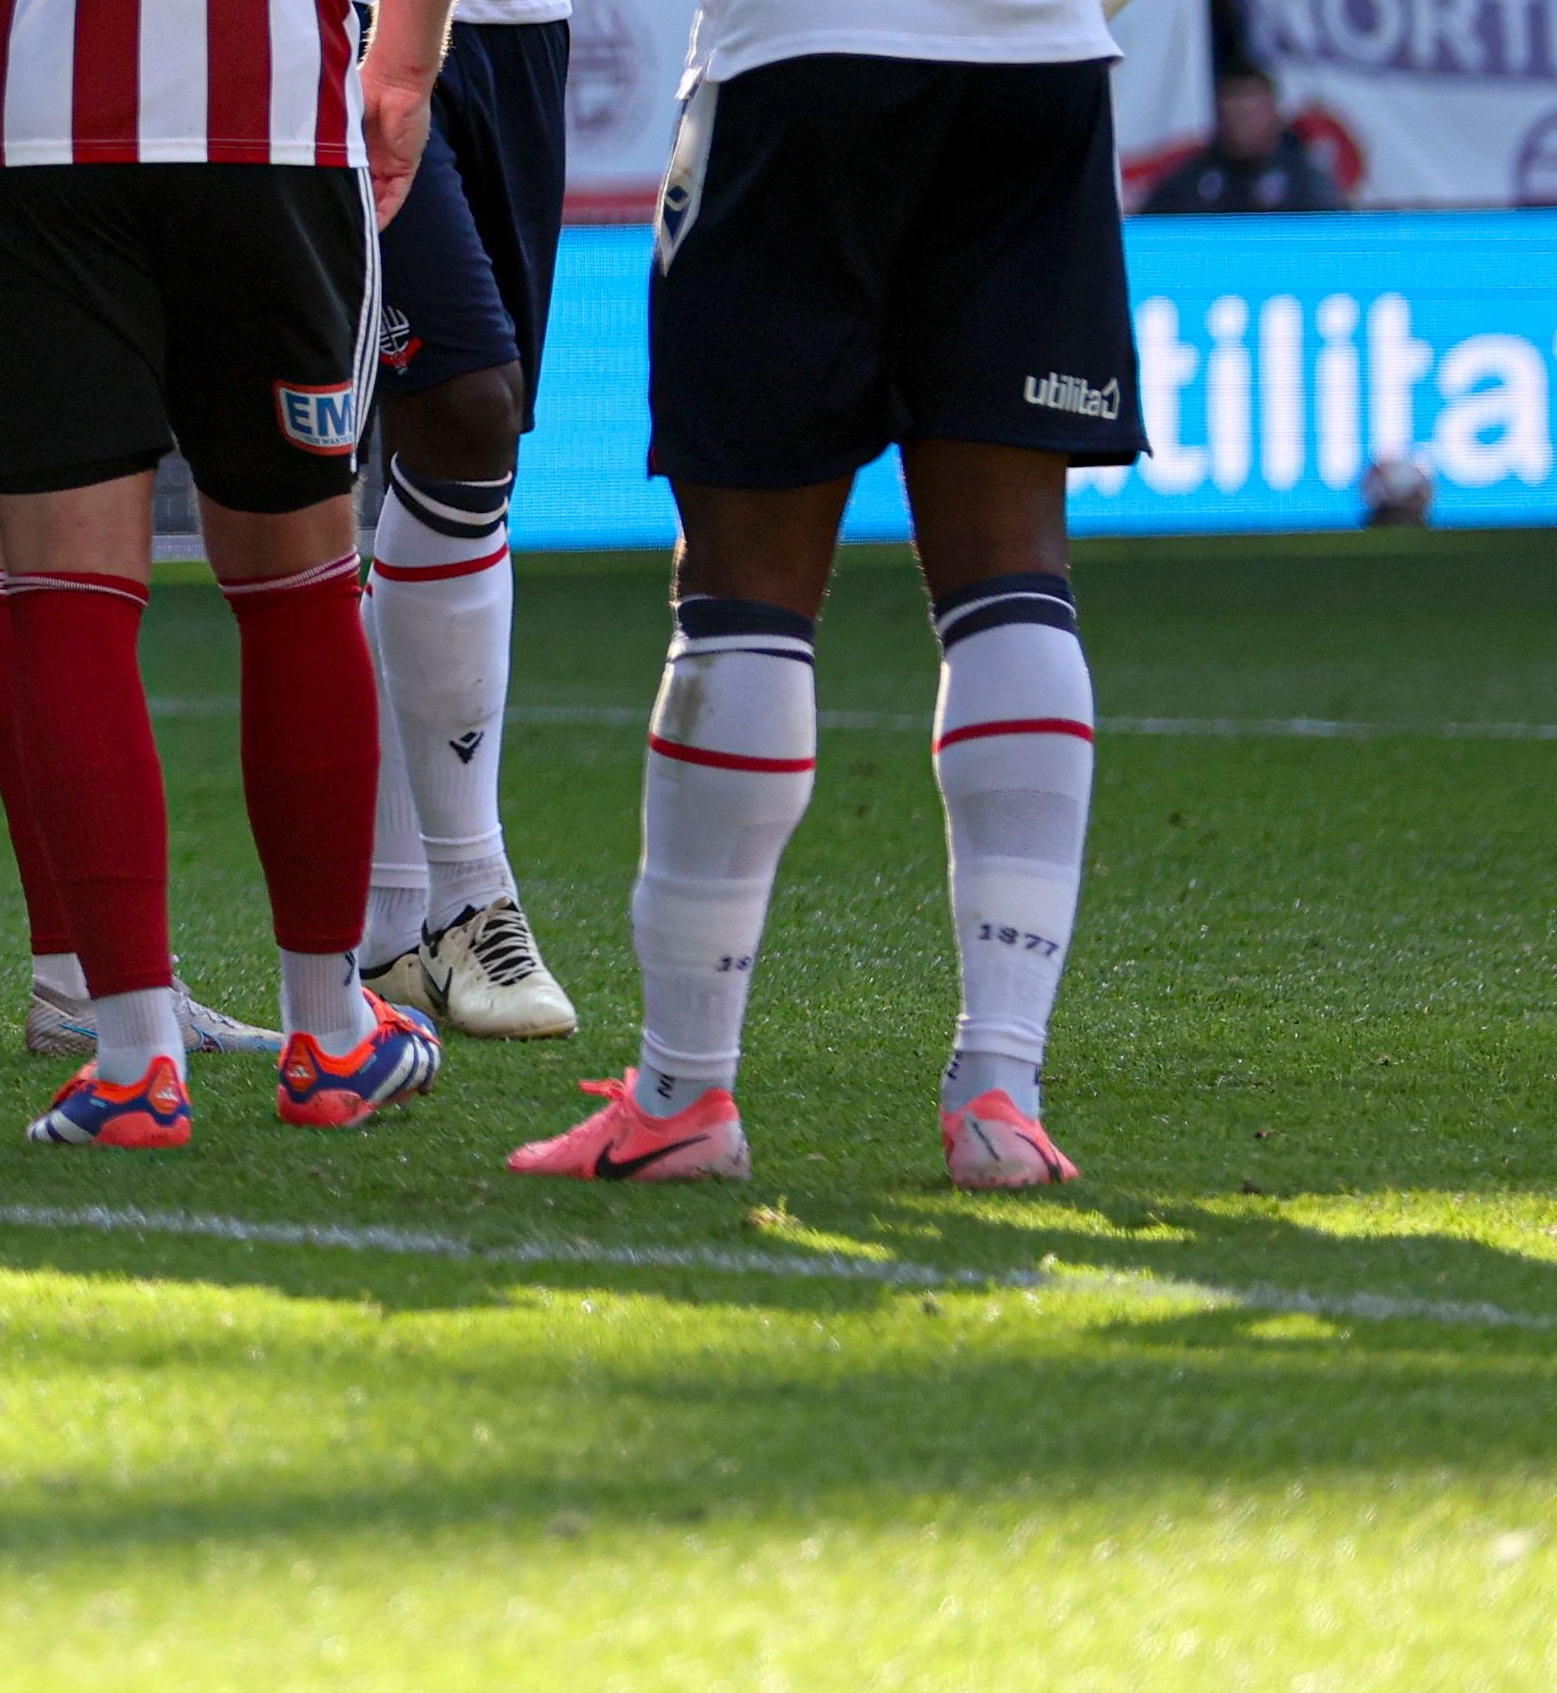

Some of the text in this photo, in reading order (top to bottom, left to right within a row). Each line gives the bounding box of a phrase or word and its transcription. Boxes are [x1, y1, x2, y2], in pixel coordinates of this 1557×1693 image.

[1024, 371, 1102, 418] utilita
[1066, 292, 1553, 496] tilita
[977, 922, 1061, 958] 1877
